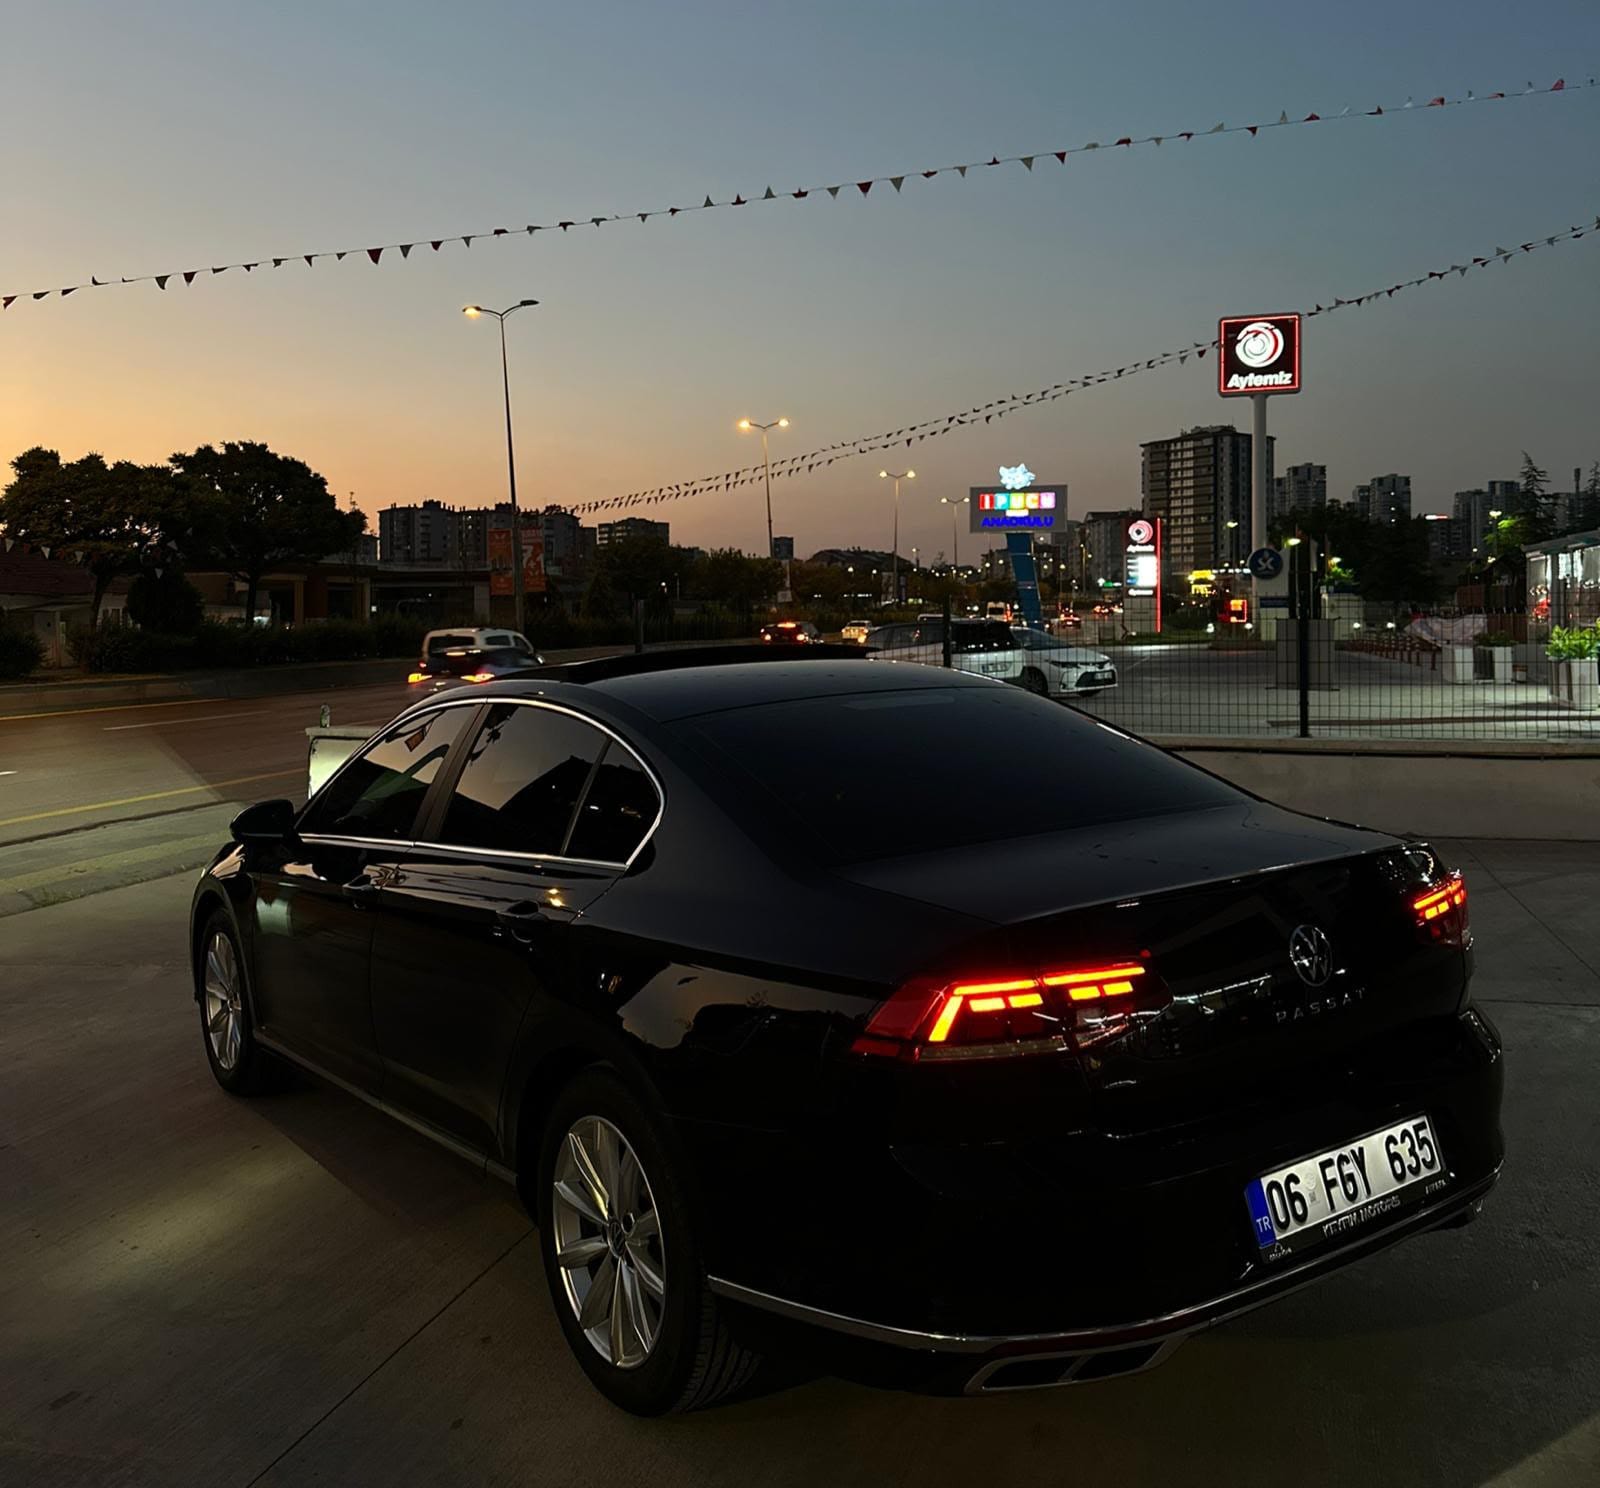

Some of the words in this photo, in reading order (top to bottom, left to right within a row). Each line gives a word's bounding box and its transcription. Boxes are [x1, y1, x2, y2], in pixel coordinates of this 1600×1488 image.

[1227, 371, 1292, 389] Aytemiz
[1276, 986, 1367, 1023] PASSAT
[1265, 1172, 1309, 1232] 06
[1318, 1146, 1372, 1212] FGY
[1384, 1120, 1436, 1184] 635
[1256, 1215, 1272, 1233] TR
